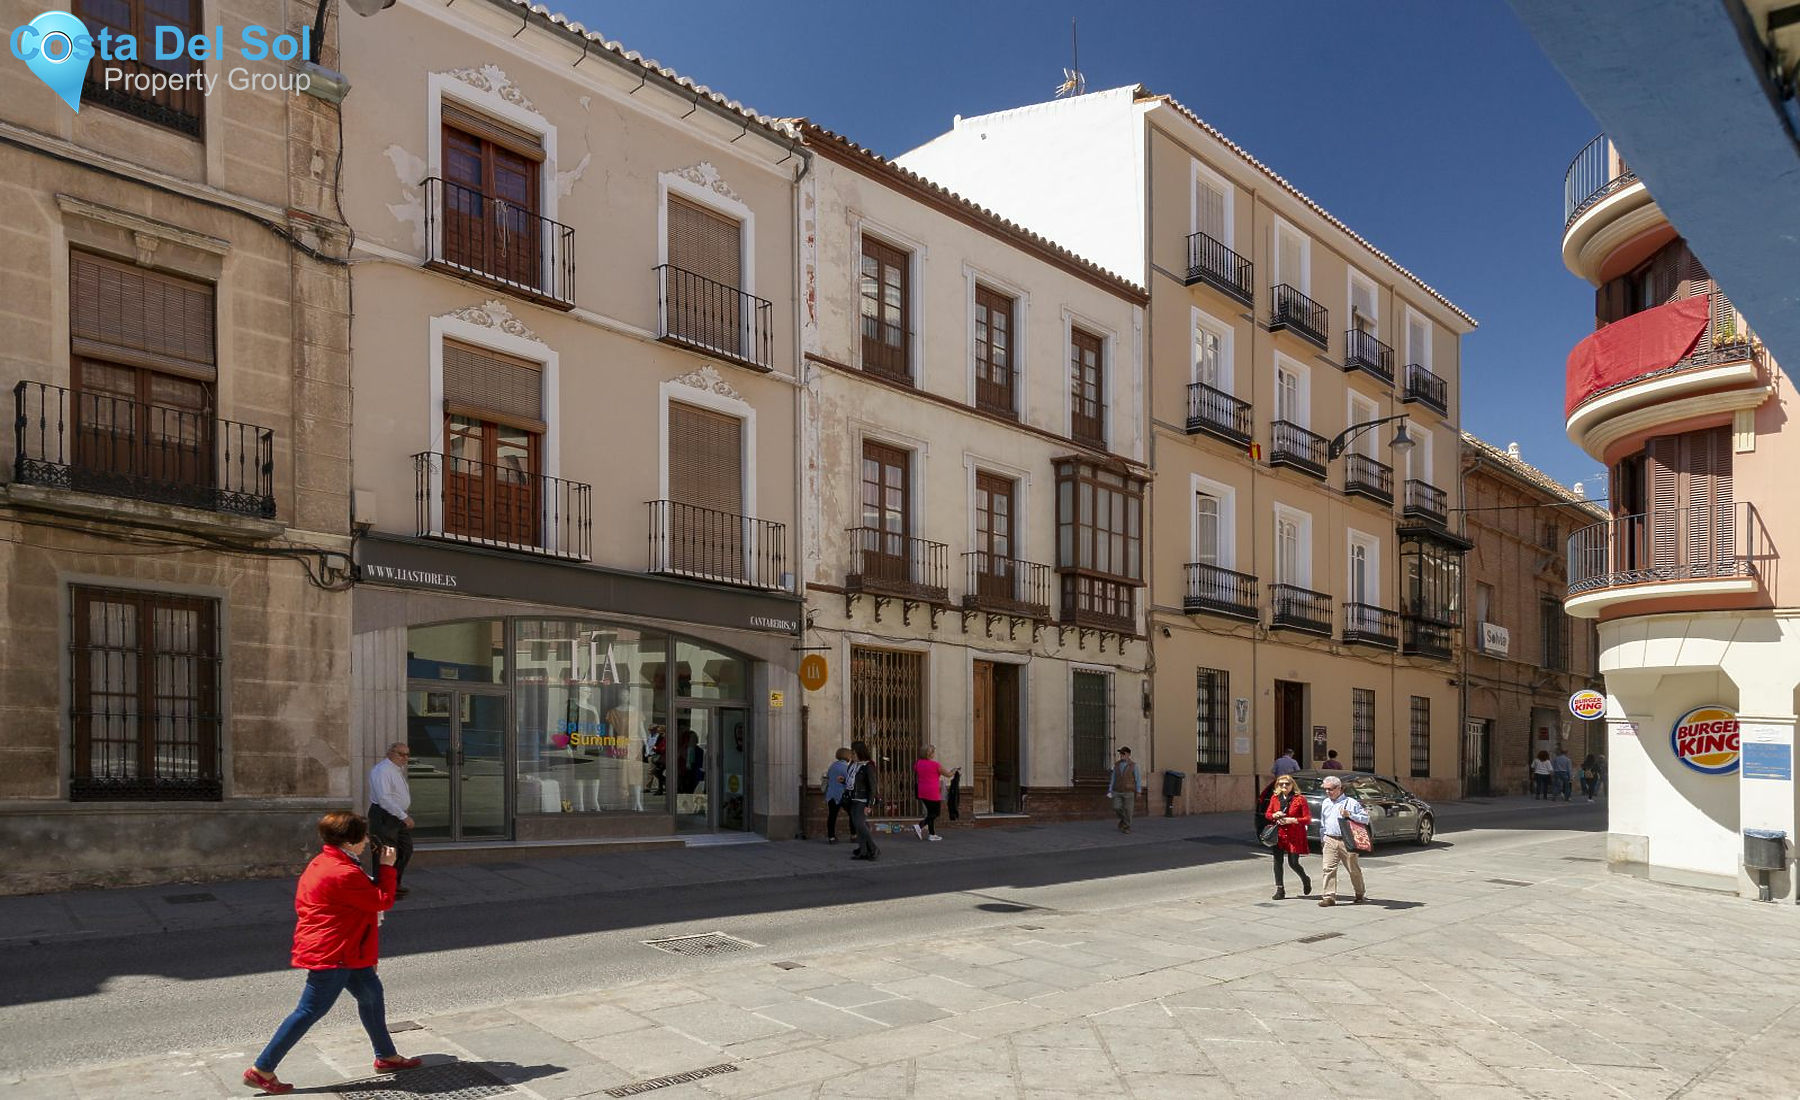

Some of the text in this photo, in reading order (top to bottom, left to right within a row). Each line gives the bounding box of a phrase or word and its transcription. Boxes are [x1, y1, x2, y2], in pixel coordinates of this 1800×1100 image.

[367, 564, 457, 587] WWW.LIASTORE.ES
[791, 621, 797, 630] 9
[1574, 697, 1602, 705] BURGER
[1574, 702, 1603, 711] KING
[570, 732, 630, 748] Summer
[1678, 733, 1741, 758] KING
